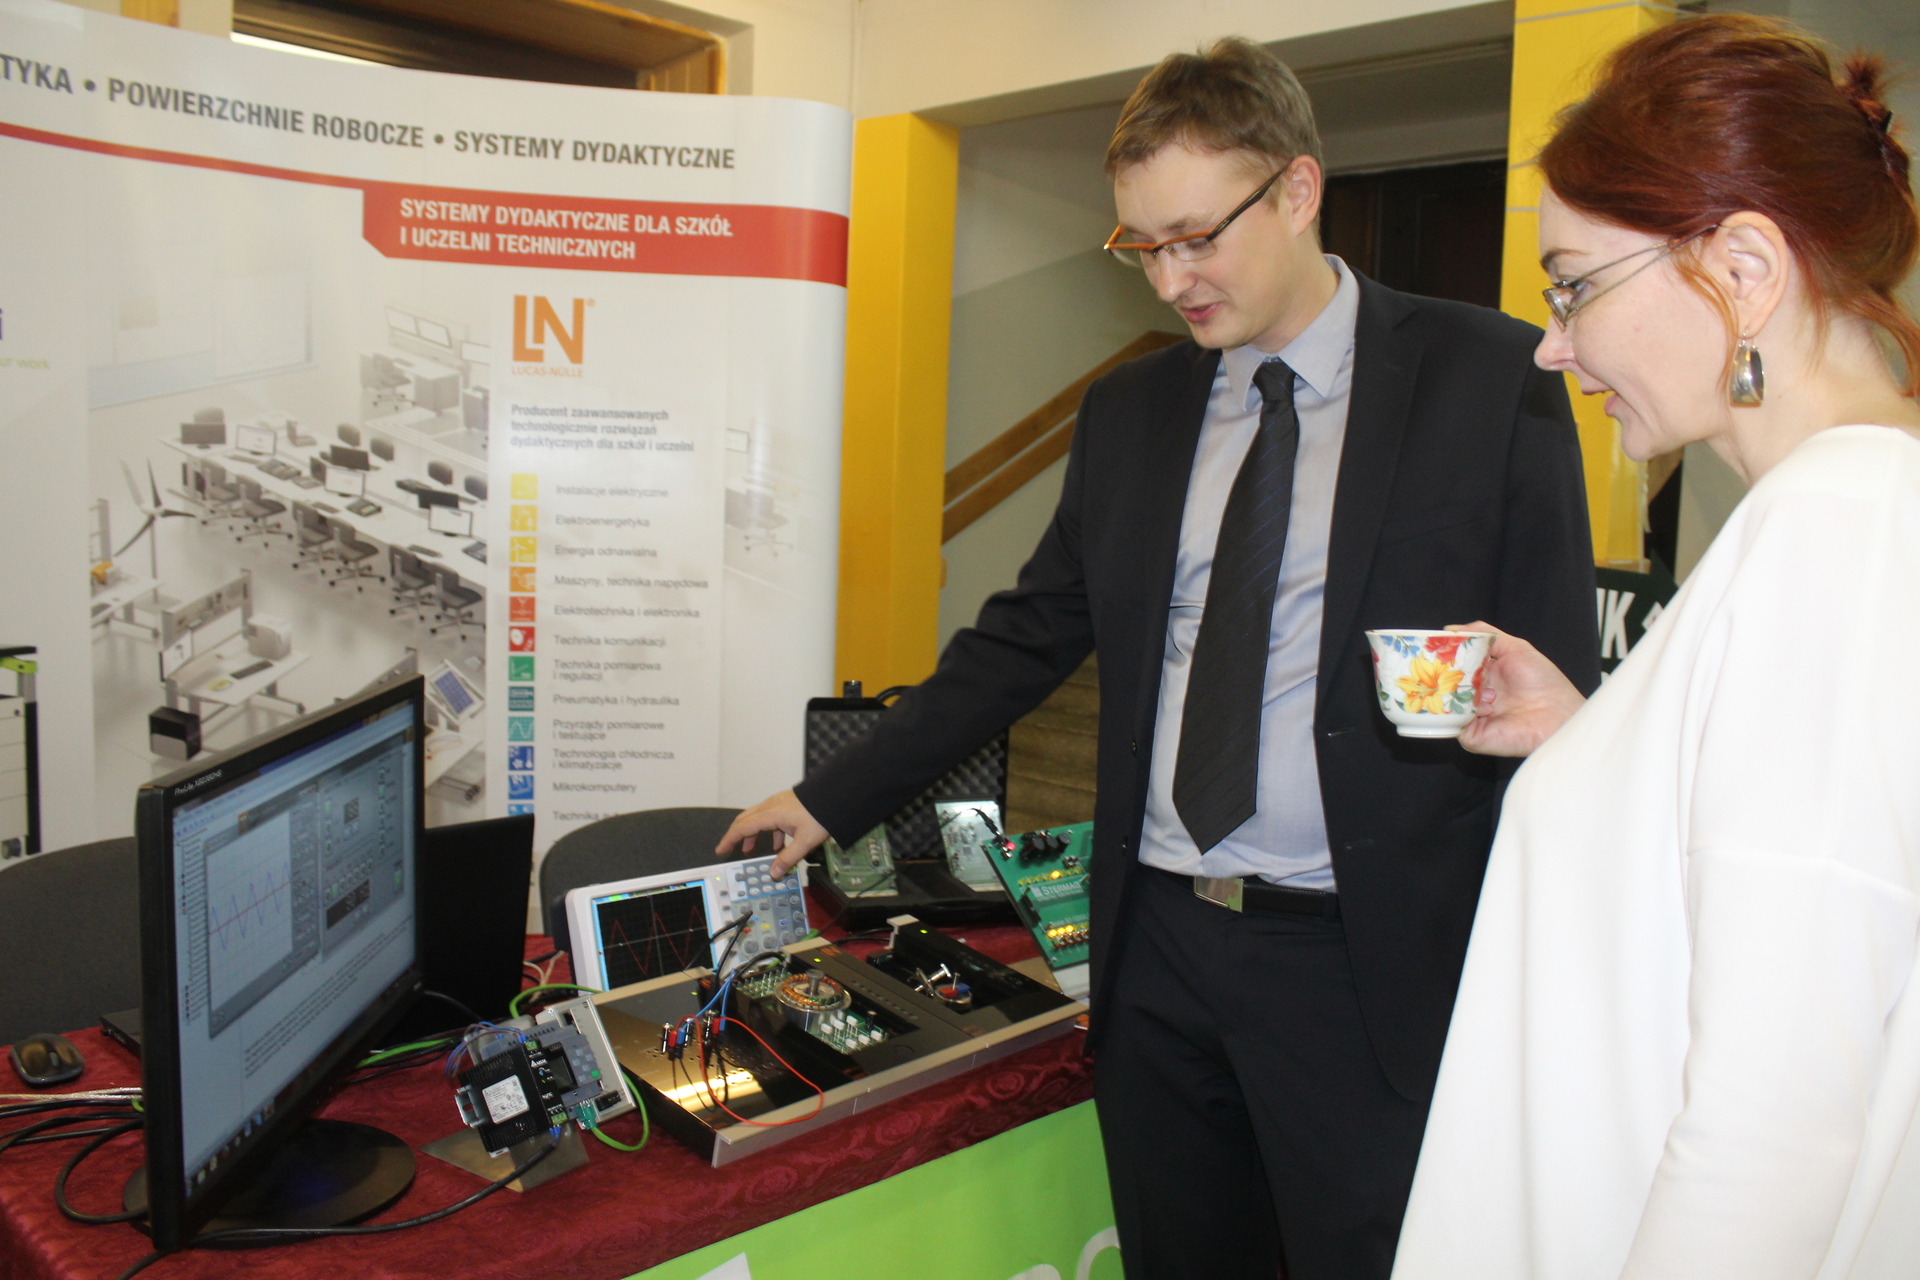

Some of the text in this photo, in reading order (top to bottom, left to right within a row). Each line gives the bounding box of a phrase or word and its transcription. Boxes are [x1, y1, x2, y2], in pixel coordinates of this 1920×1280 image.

[0, 53, 735, 170] TYKA POWIERZCHNIE ROBOCZE SYSTEMY DYDAKTYCZNE
[400, 198, 733, 237] SYSTEMY DYDAKTYCZNE DLA SZKÓŁ
[400, 227, 636, 259] I UCZELNI TECHNICZNYCH
[511, 404, 669, 422] Producent zaawansowanych
[511, 420, 597, 434] technologicznie
[510, 435, 594, 450] dydaktycznych
[596, 437, 614, 449] dla
[655, 440, 695, 451] uczelni
[554, 544, 595, 557] Energia
[553, 634, 601, 646] Technika
[553, 659, 602, 669] Technika
